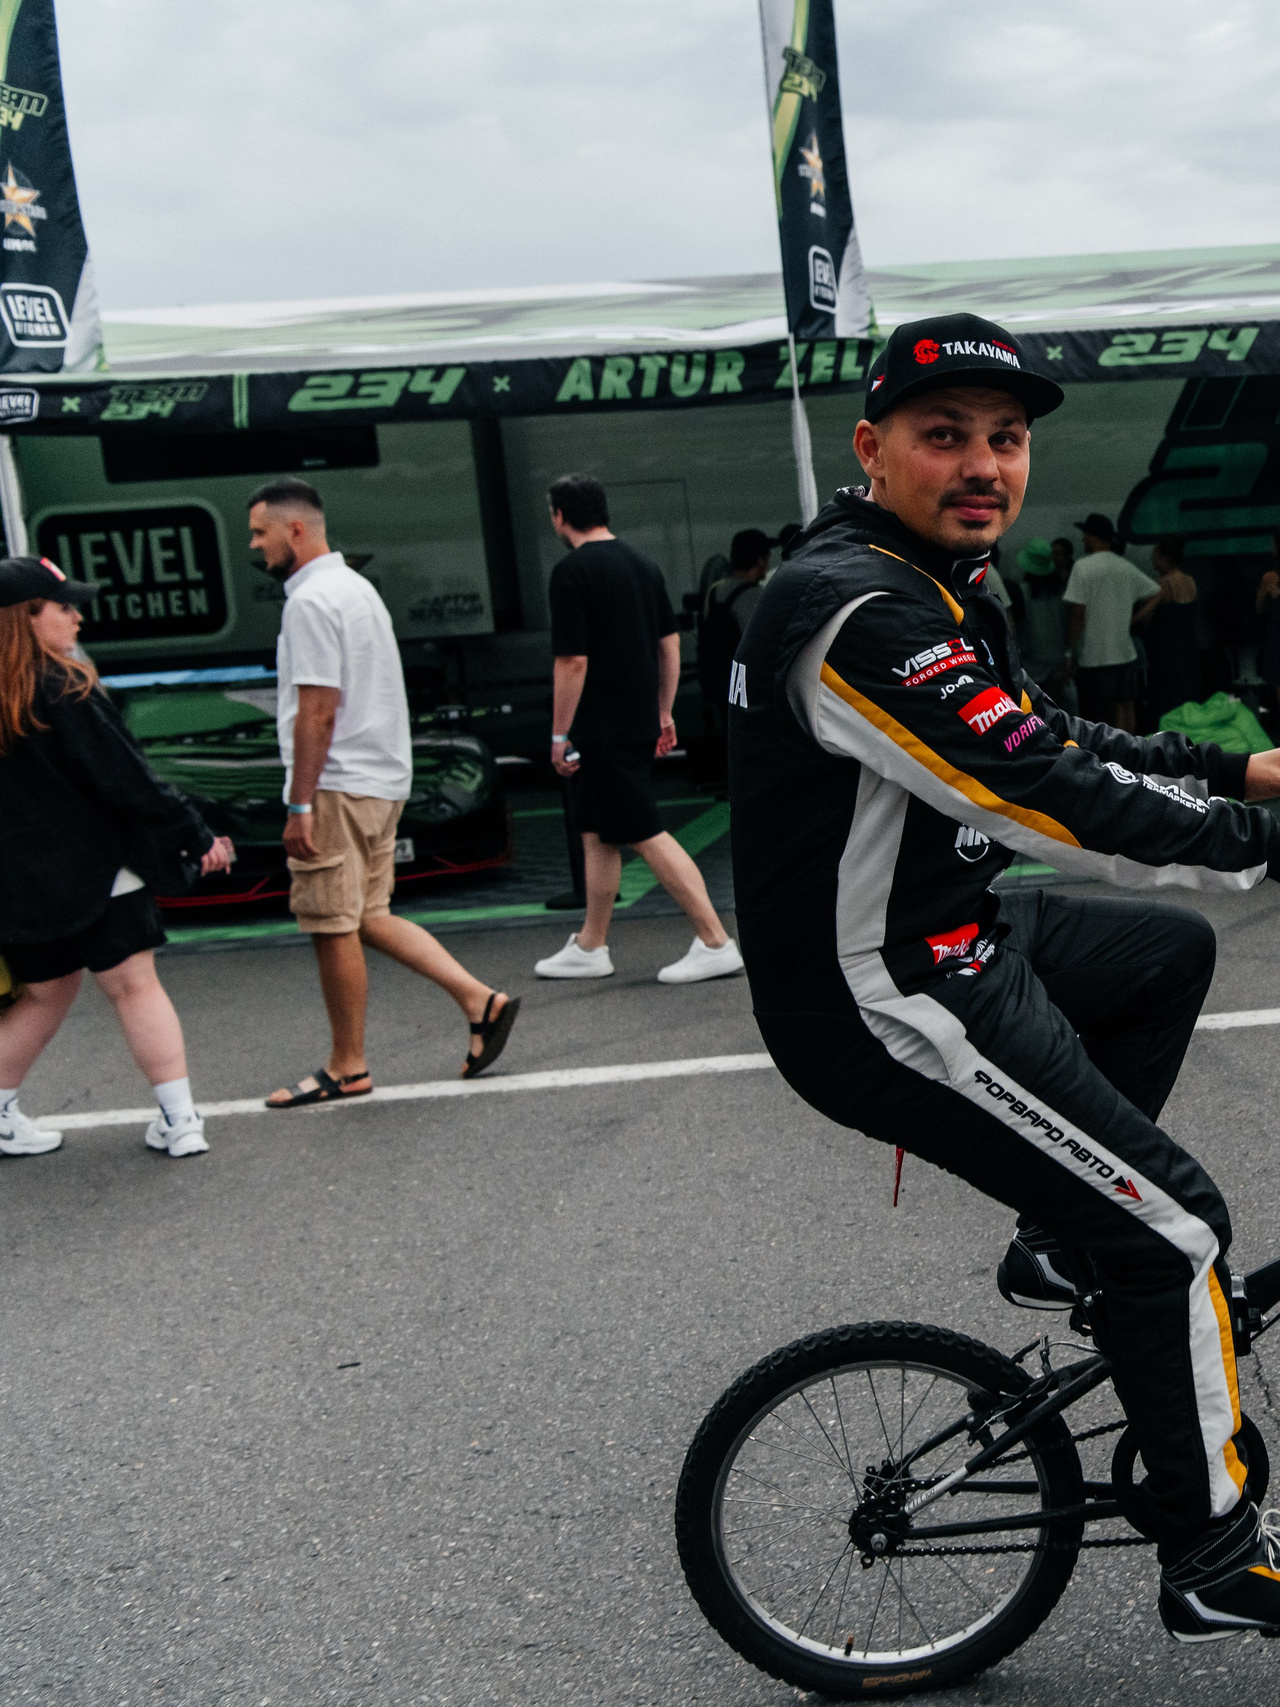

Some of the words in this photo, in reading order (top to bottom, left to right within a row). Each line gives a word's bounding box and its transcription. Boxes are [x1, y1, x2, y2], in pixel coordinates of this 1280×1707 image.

[6, 294, 57, 322] LEVEL
[942, 340, 1021, 369] TAKAYAMA
[1097, 326, 1261, 367] 234
[288, 367, 467, 412] 234
[555, 351, 746, 402] ARTUR
[773, 340, 884, 390] ZEL
[101, 400, 177, 421] 234
[57, 526, 205, 587] LEVEL
[90, 588, 211, 622] ITCHEN
[905, 662, 947, 687] FORGED
[974, 1069, 1065, 1143] ФОРВАРД
[1061, 1138, 1115, 1179] АВТО
